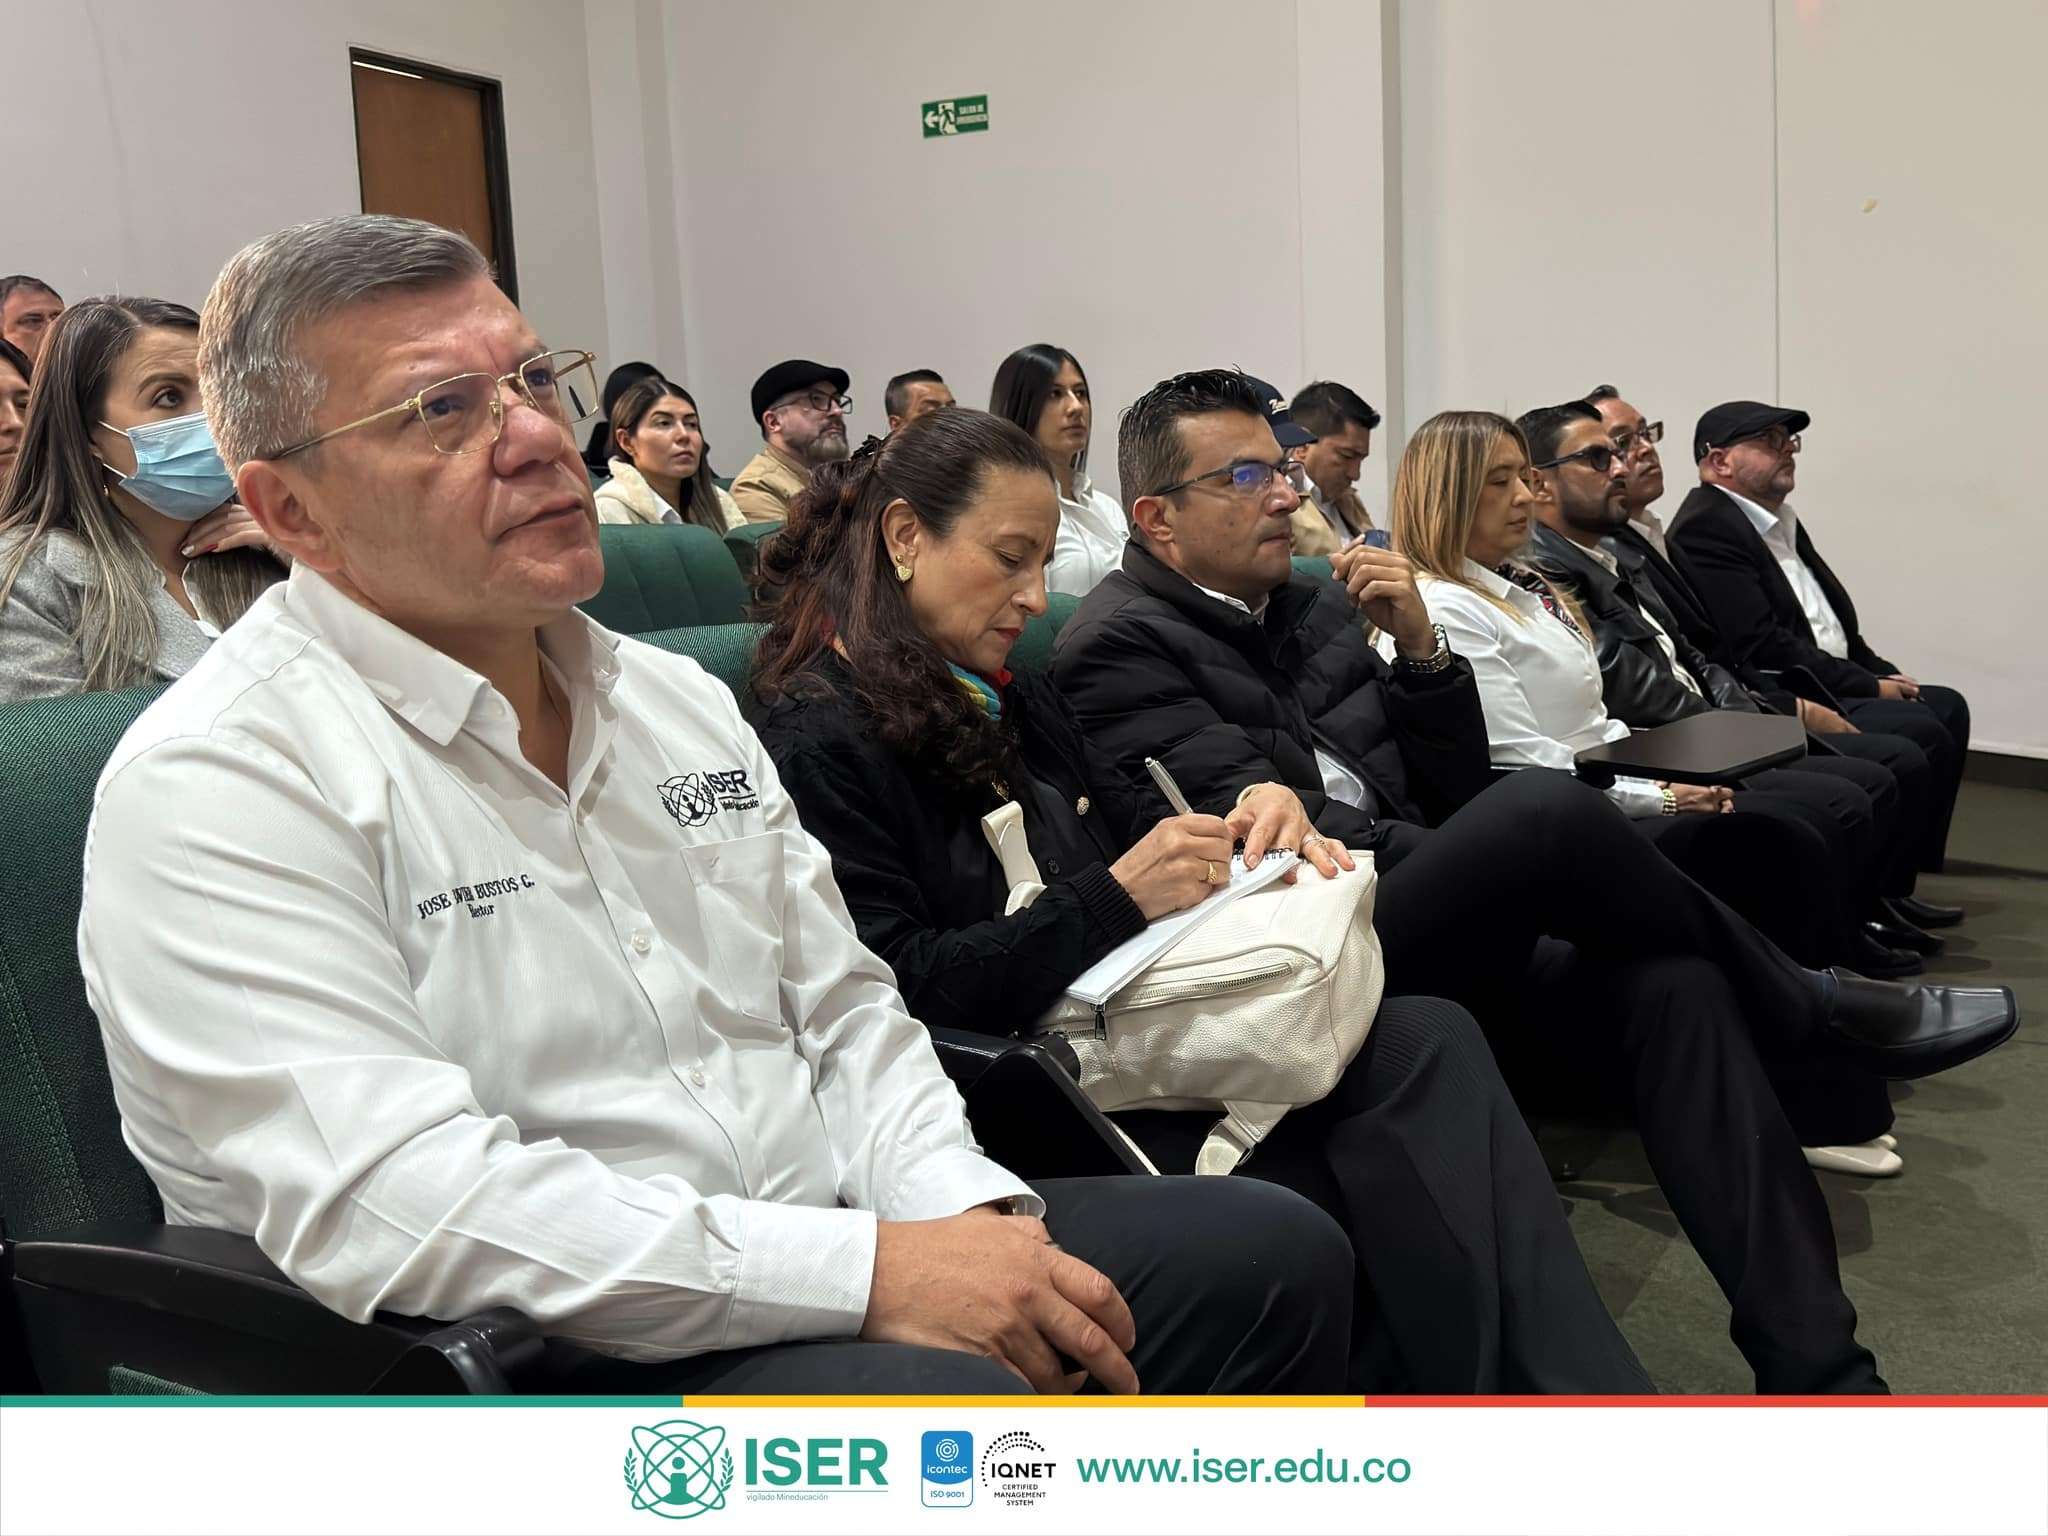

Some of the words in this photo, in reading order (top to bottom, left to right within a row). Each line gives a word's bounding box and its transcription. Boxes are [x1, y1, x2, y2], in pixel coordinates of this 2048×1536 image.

[702, 769, 753, 794] ISER
[417, 893, 452, 919] JOSE
[473, 876, 519, 899] BUSTOS
